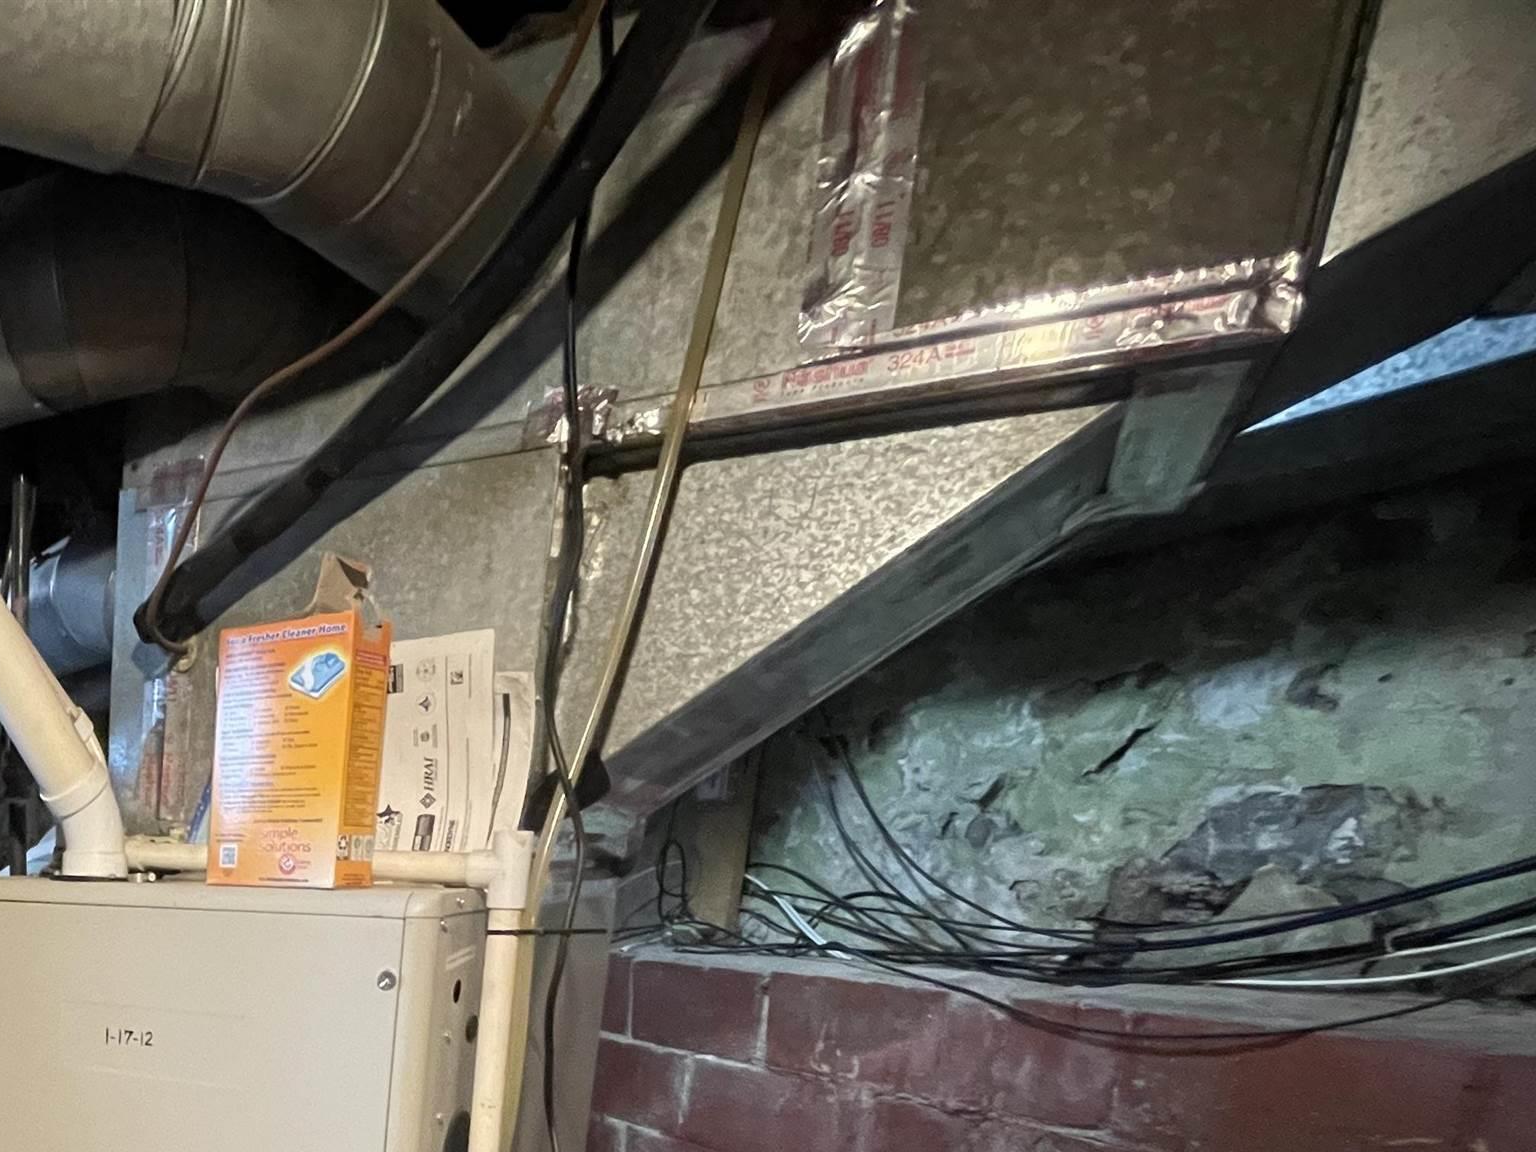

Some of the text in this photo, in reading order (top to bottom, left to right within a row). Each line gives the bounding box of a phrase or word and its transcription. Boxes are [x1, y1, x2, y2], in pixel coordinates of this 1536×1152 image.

[887, 347, 942, 372] 324A
[282, 628, 315, 638] Cleaner
[319, 624, 346, 634] Home
[259, 840, 312, 852] olutions
[105, 1027, 153, 1046] 1-17-12
